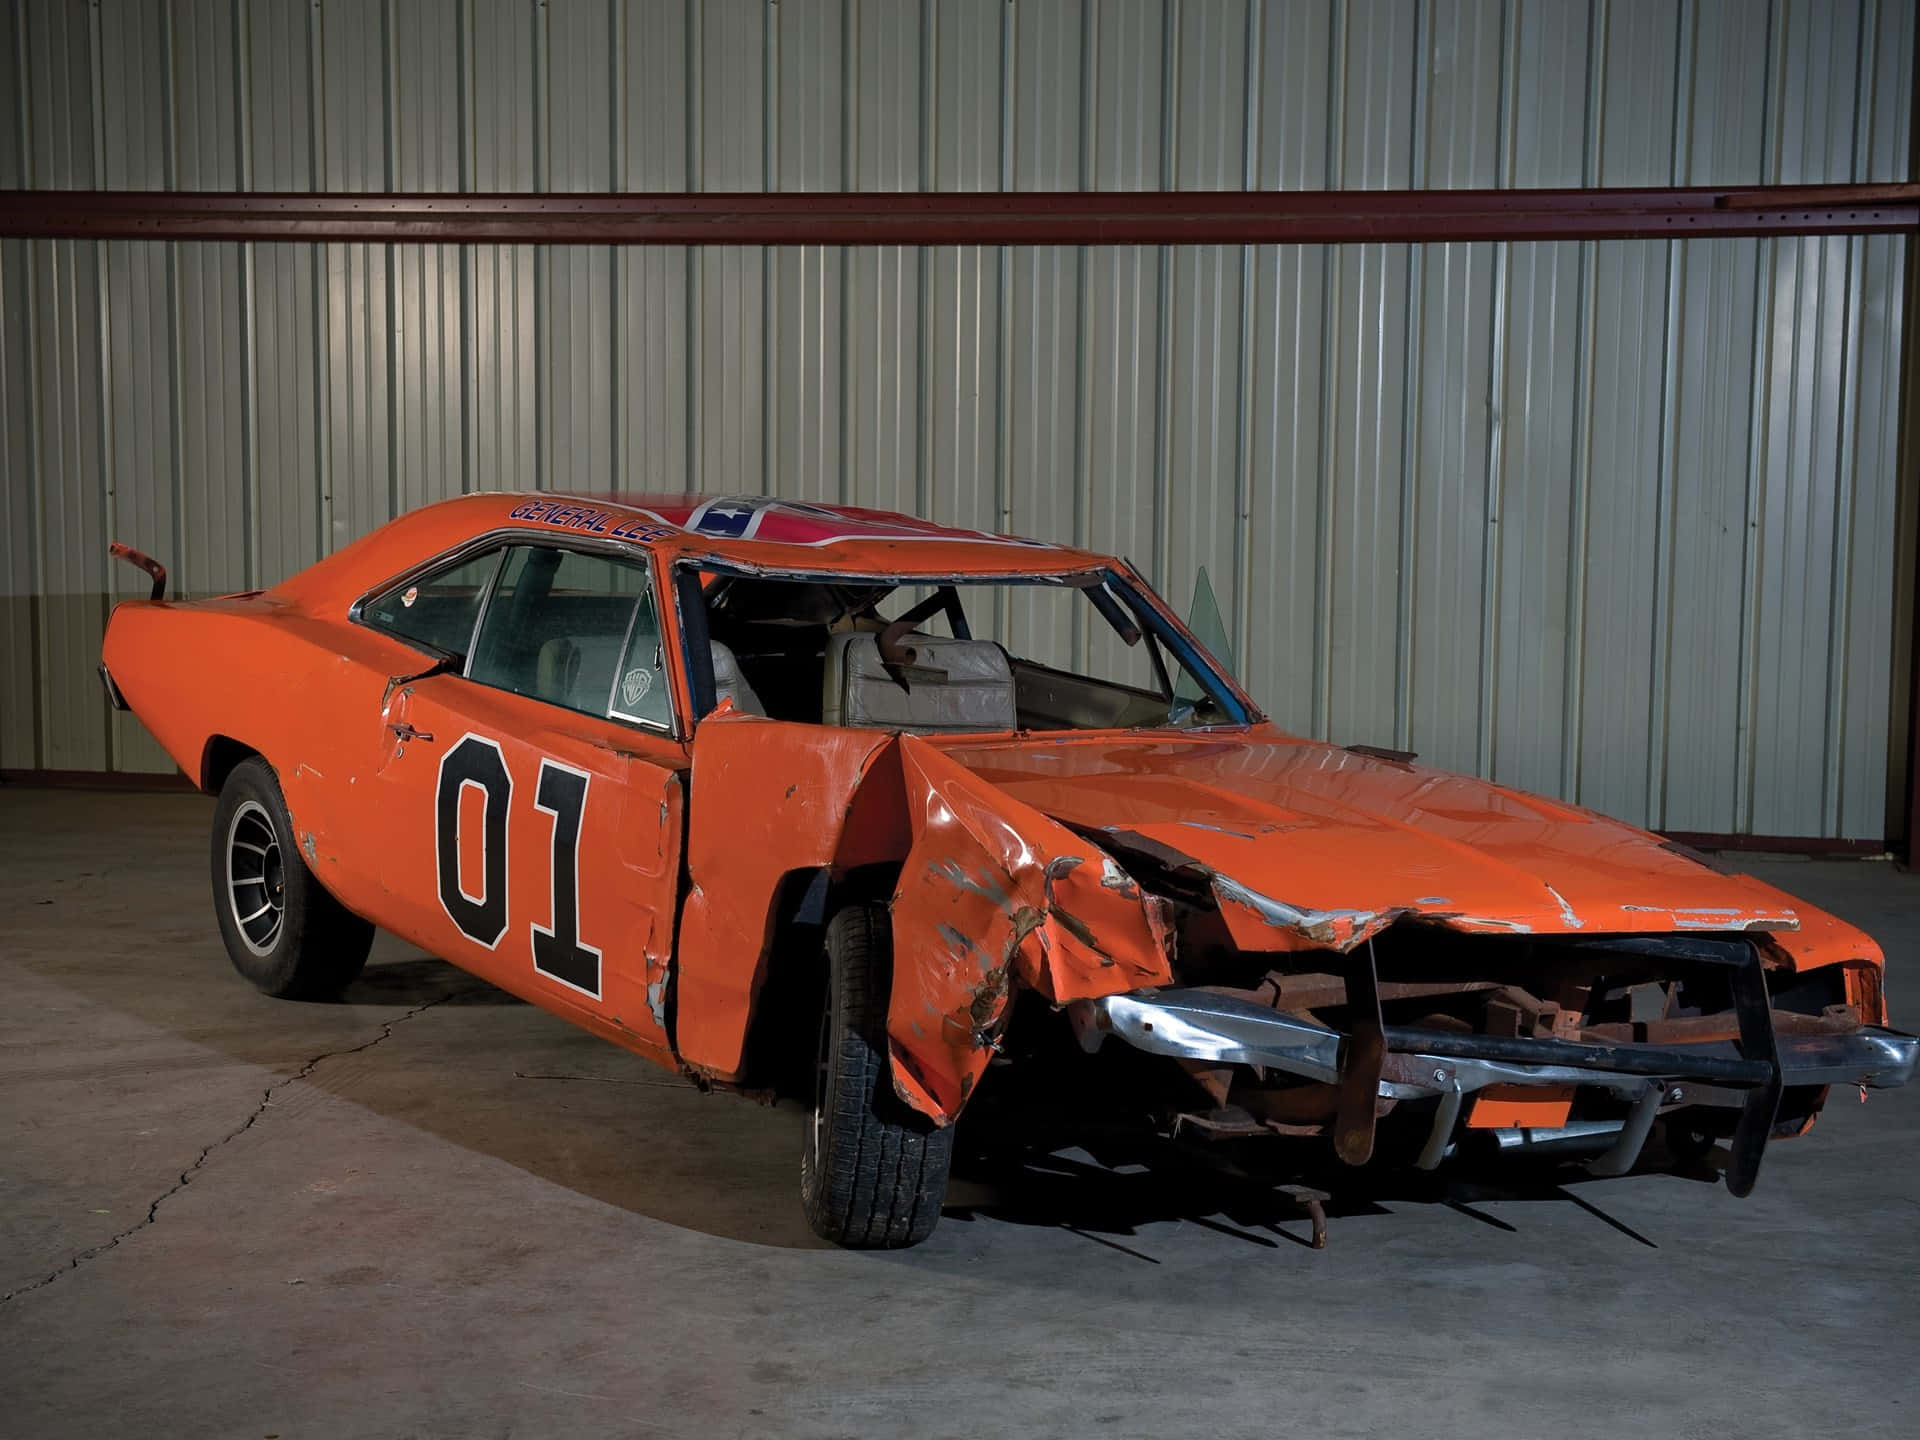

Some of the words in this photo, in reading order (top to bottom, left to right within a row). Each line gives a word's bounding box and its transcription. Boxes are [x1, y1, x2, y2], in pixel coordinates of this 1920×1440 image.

[509, 501, 615, 534] GENERAL
[610, 519, 679, 543] LEE
[436, 733, 602, 1000] 01
